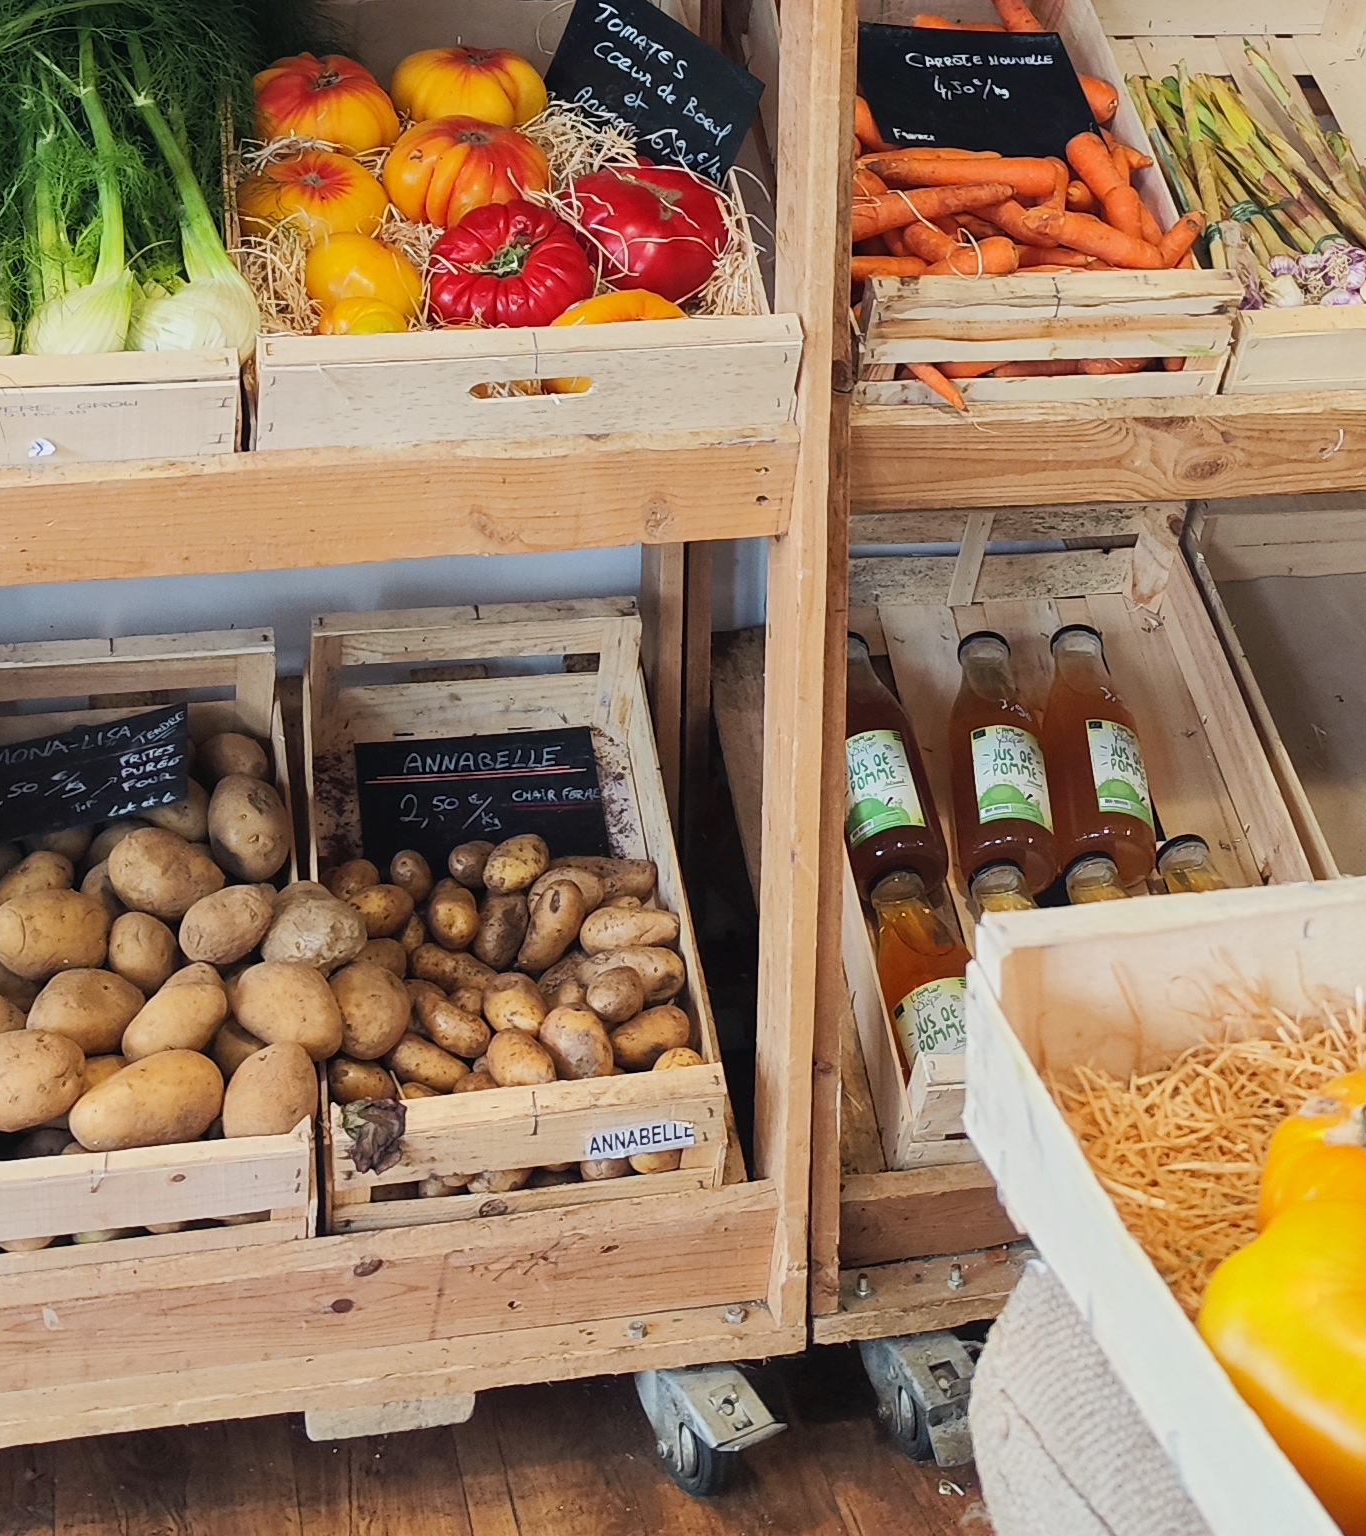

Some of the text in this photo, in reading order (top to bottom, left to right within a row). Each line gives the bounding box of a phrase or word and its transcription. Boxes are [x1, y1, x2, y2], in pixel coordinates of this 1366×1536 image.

[593, 2, 688, 80] TOMATES
[623, 90, 649, 110] et
[656, 83, 677, 105] de
[119, 744, 176, 766] FRITES
[403, 745, 563, 774] ANNABELLE
[992, 748, 1034, 765] JUS DE
[1110, 743, 1130, 761] JUS
[848, 752, 890, 781] JUS DE
[992, 762, 1038, 781] POMME
[121, 772, 177, 792] FOUR
[850, 765, 897, 796] POMME
[511, 788, 557, 802] CHAIR
[915, 1003, 959, 1039] JUS DE
[919, 1019, 966, 1052] POMME
[589, 1122, 695, 1155] ANNABELLE
